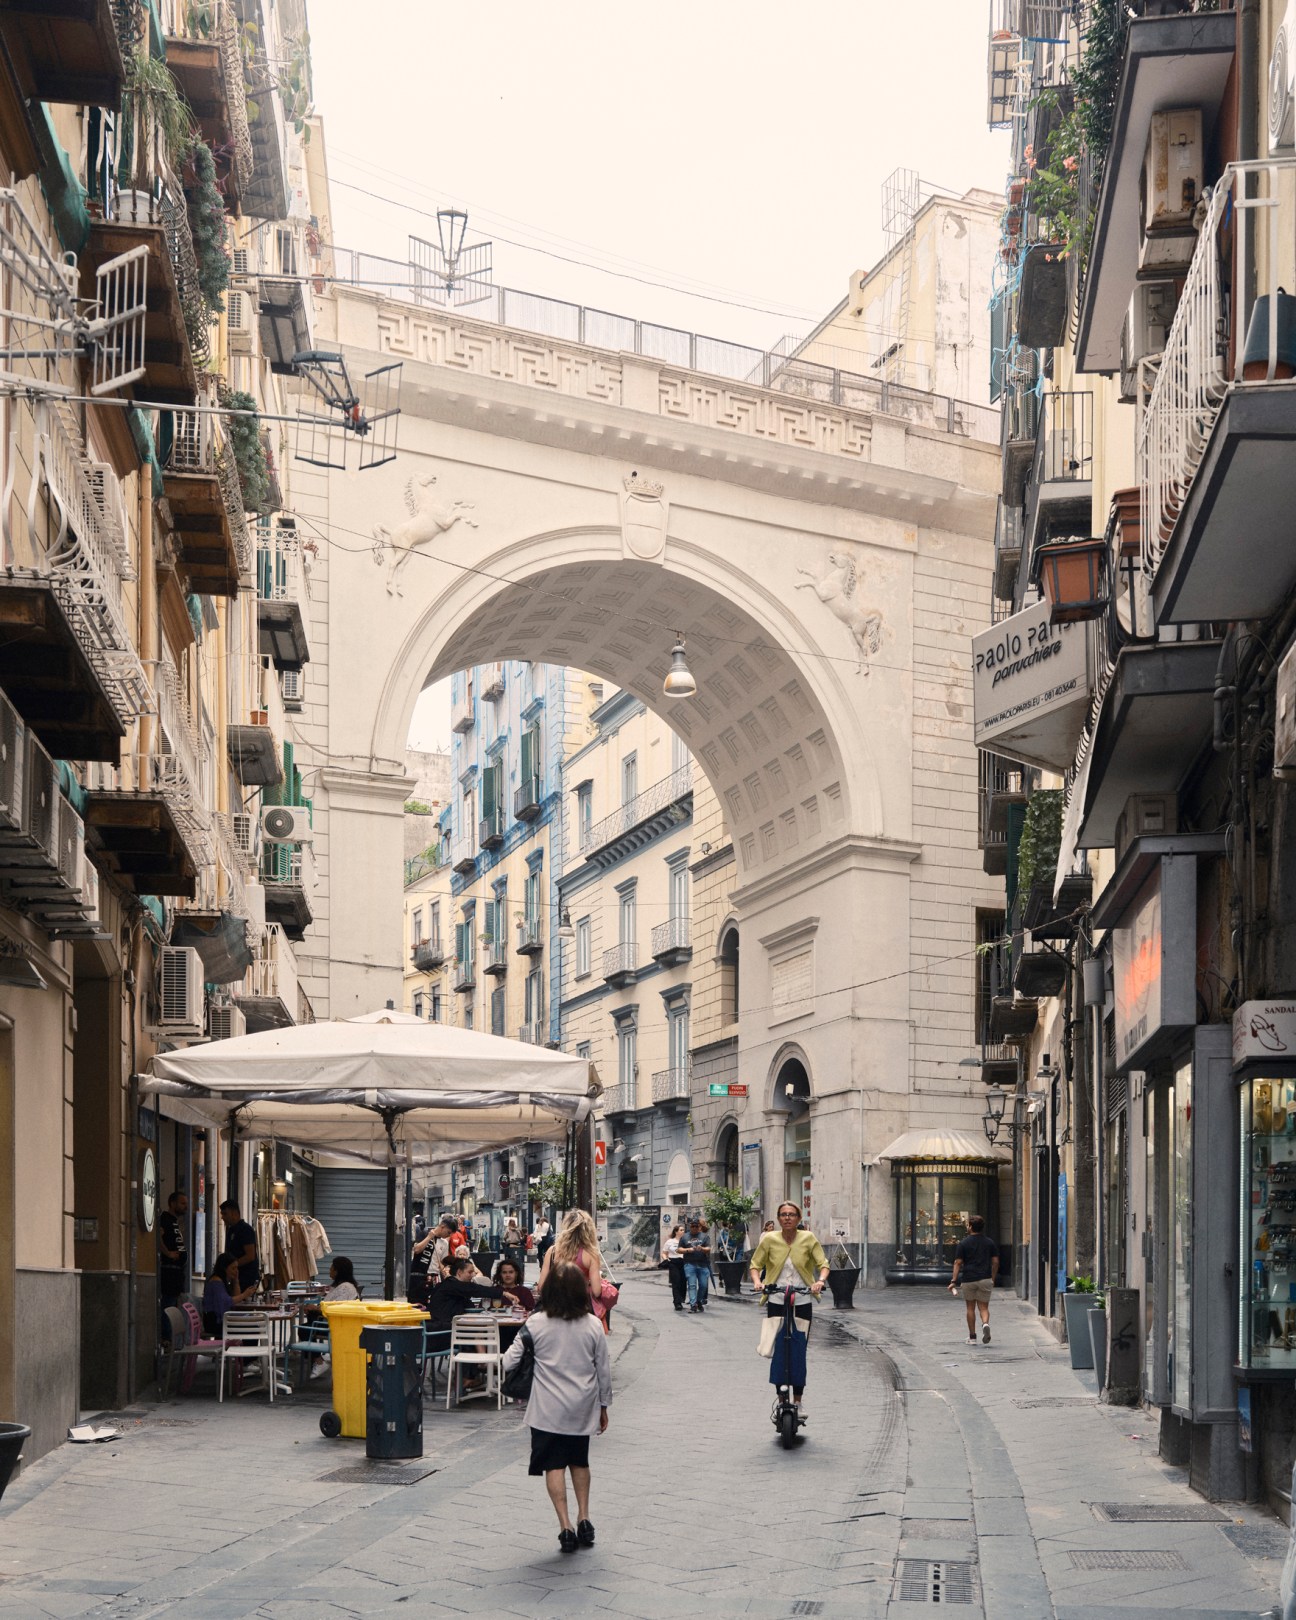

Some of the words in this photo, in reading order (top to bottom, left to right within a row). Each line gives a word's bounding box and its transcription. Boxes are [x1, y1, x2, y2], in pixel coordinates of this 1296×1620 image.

[976, 633, 1021, 673] Paolo
[992, 640, 1061, 688] parrucchiere
[984, 696, 1040, 727] WWW.PAOLOPARISI.EU
